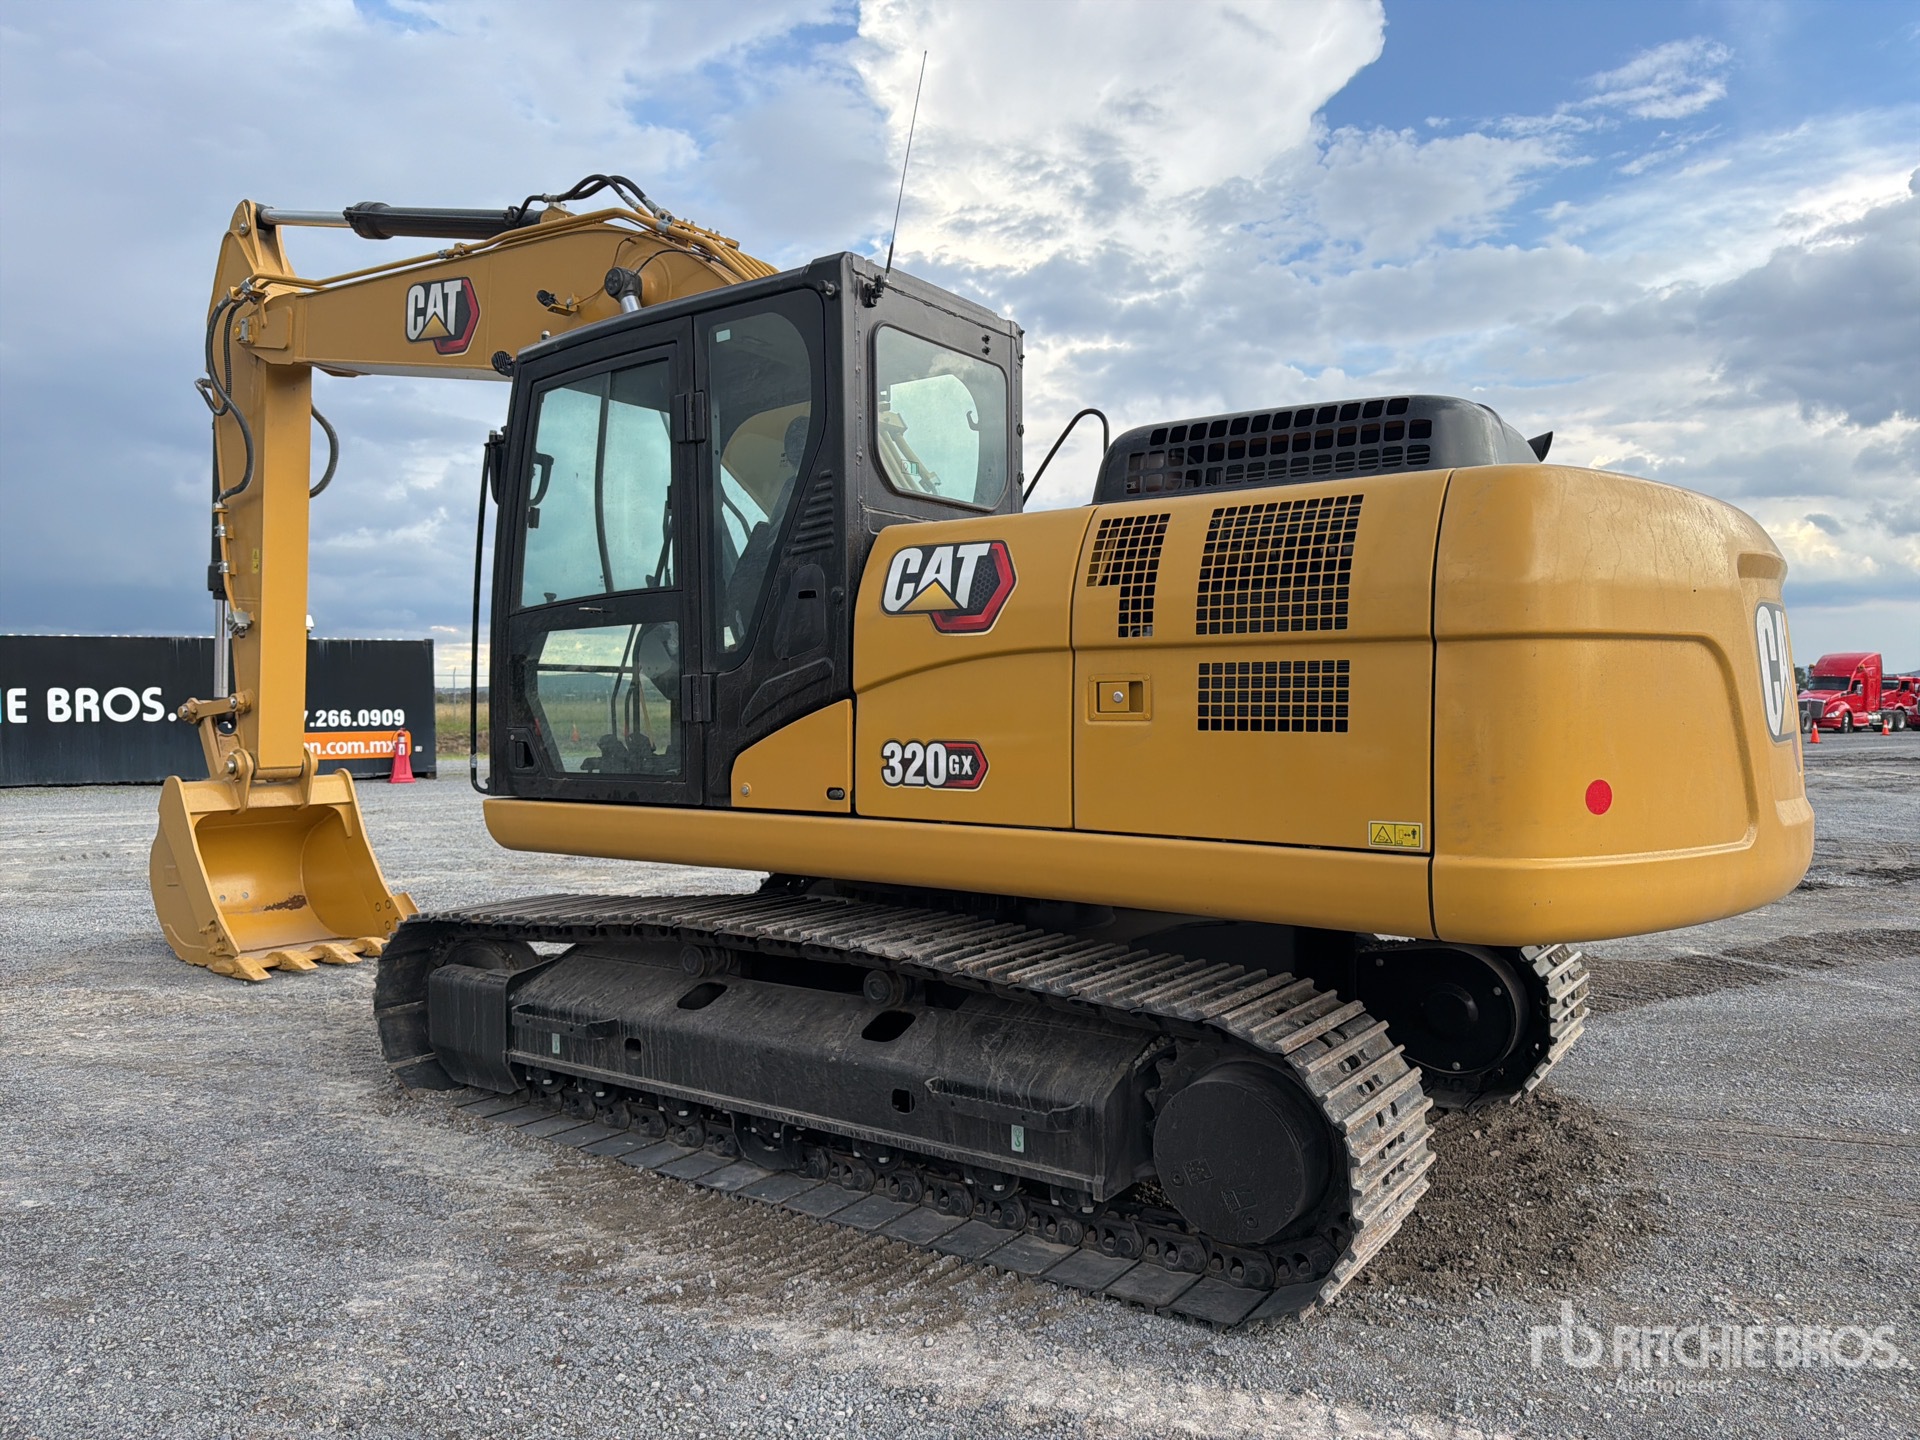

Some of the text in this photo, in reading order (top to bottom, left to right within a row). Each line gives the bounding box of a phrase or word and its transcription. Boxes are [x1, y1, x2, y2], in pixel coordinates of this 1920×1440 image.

[407, 279, 462, 340] CAT
[883, 542, 991, 612] CAT
[46, 686, 178, 723] BROS.
[882, 742, 973, 786] 320 GX
